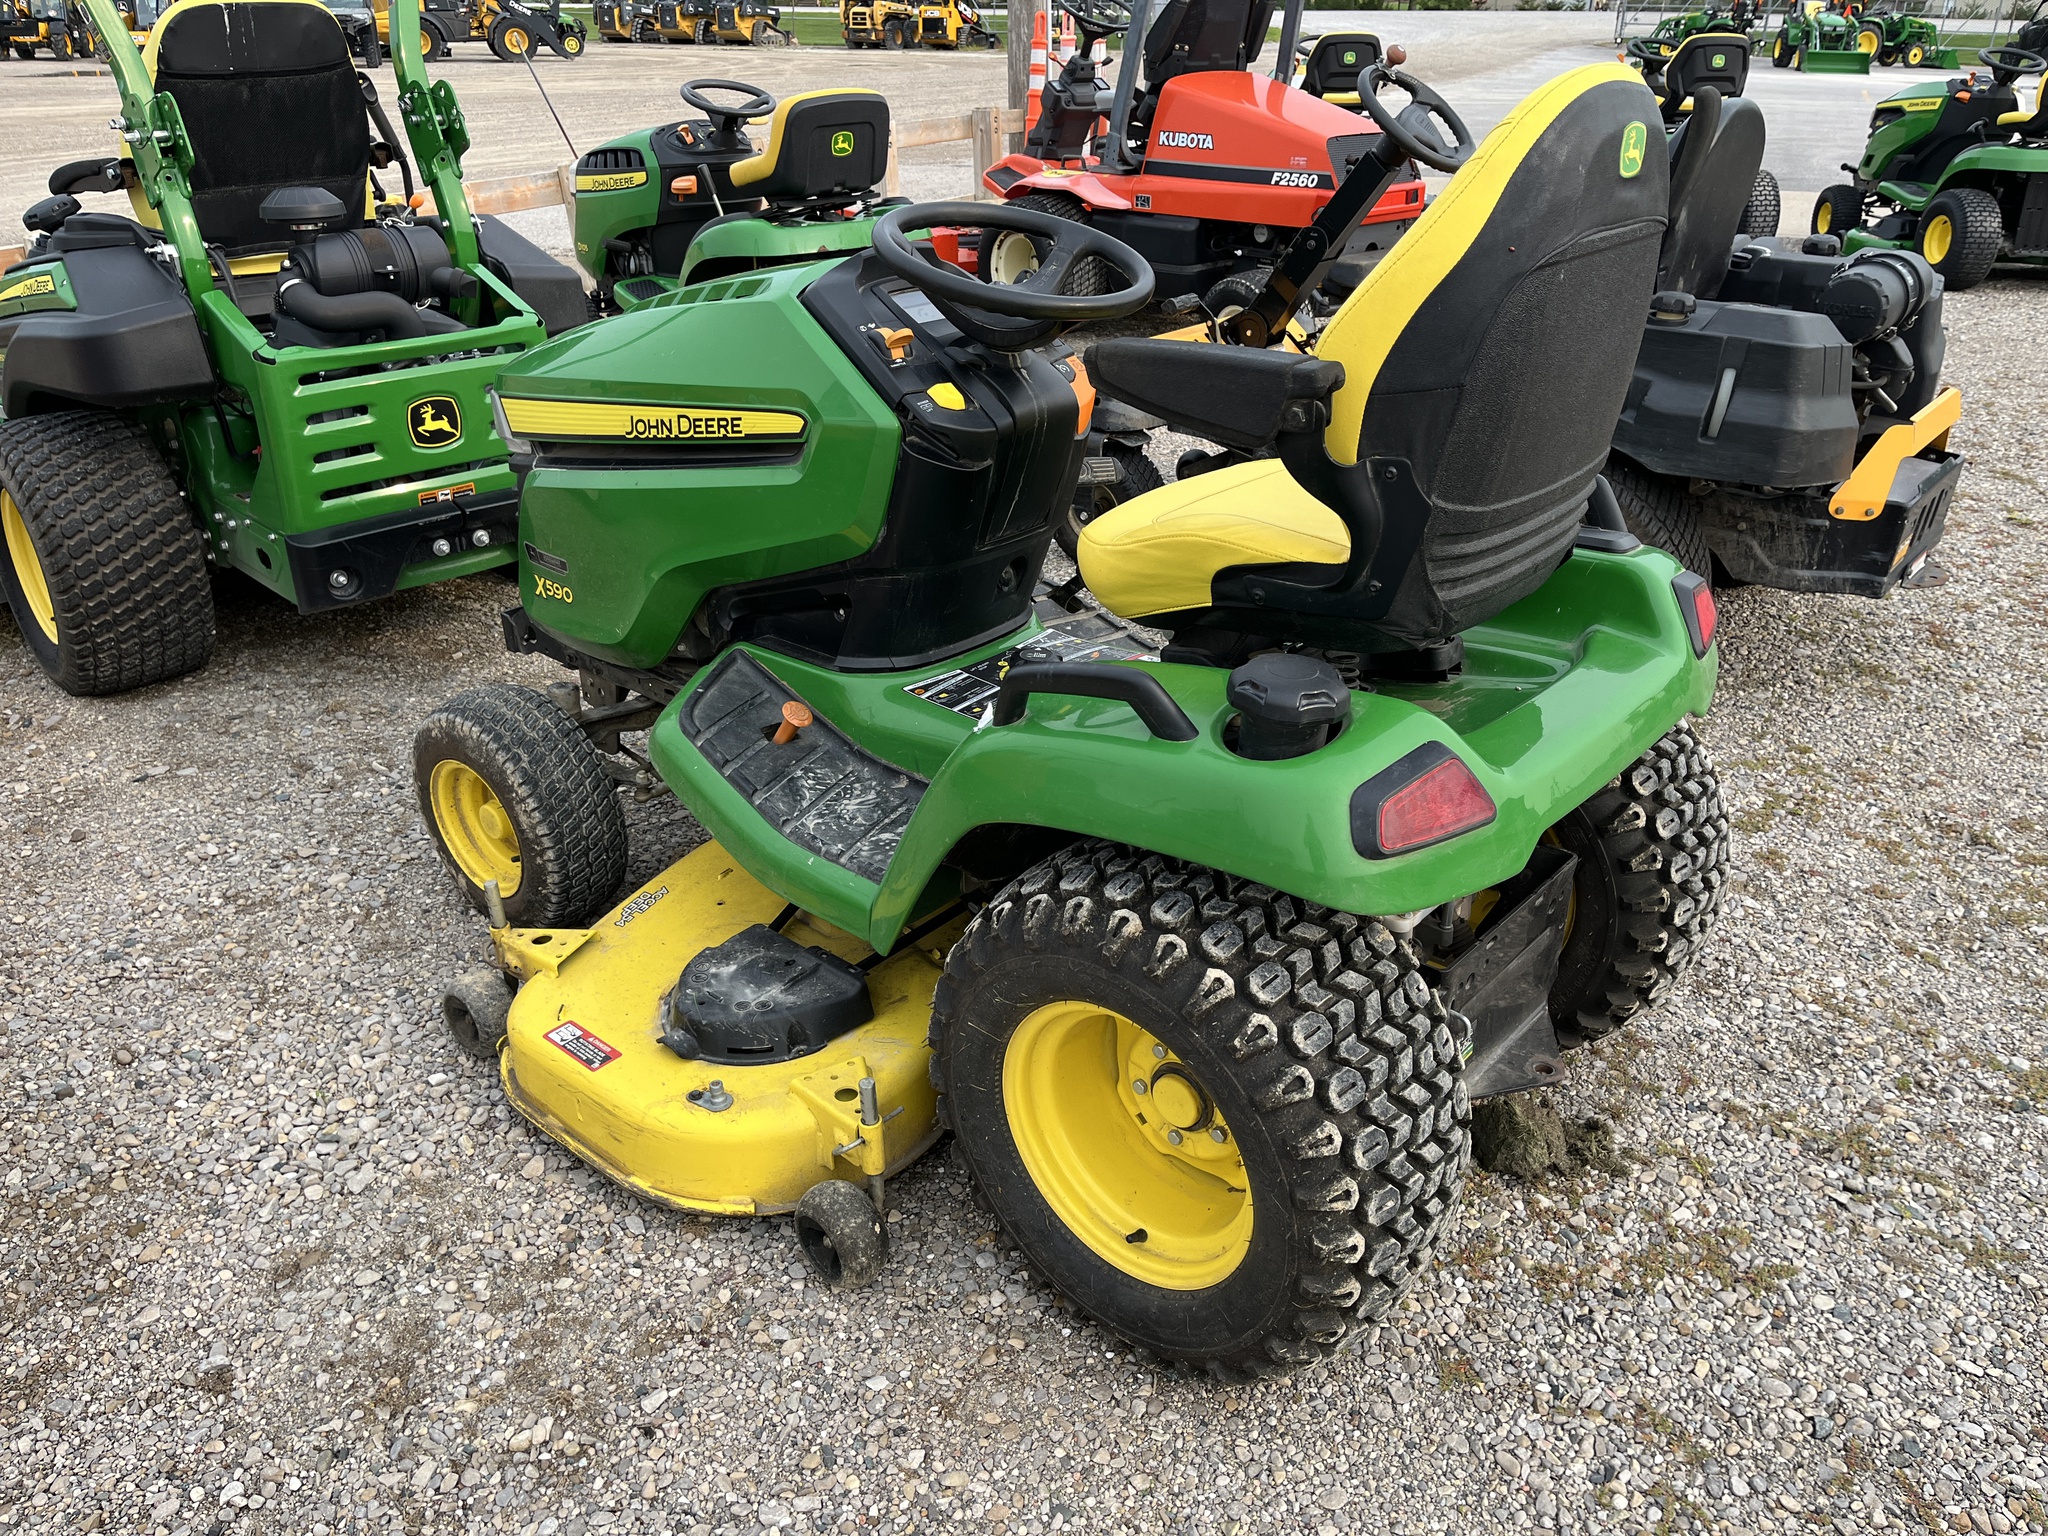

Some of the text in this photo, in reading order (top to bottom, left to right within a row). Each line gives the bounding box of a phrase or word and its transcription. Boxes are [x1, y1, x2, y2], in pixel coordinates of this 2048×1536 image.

[509, 0, 533, 17] DEERE
[957, 2, 972, 18] JCB
[1158, 131, 1214, 150] KUBOTA
[591, 176, 635, 190] JOHN DEERE
[1271, 172, 1318, 188] F2560
[33, 280, 50, 293] DEERE
[625, 414, 743, 437] JOHN DEERE
[533, 573, 574, 605] X590
[621, 891, 652, 916] DEEP
[631, 886, 669, 914] ACCEL
[593, 1038, 612, 1053] DANGER
